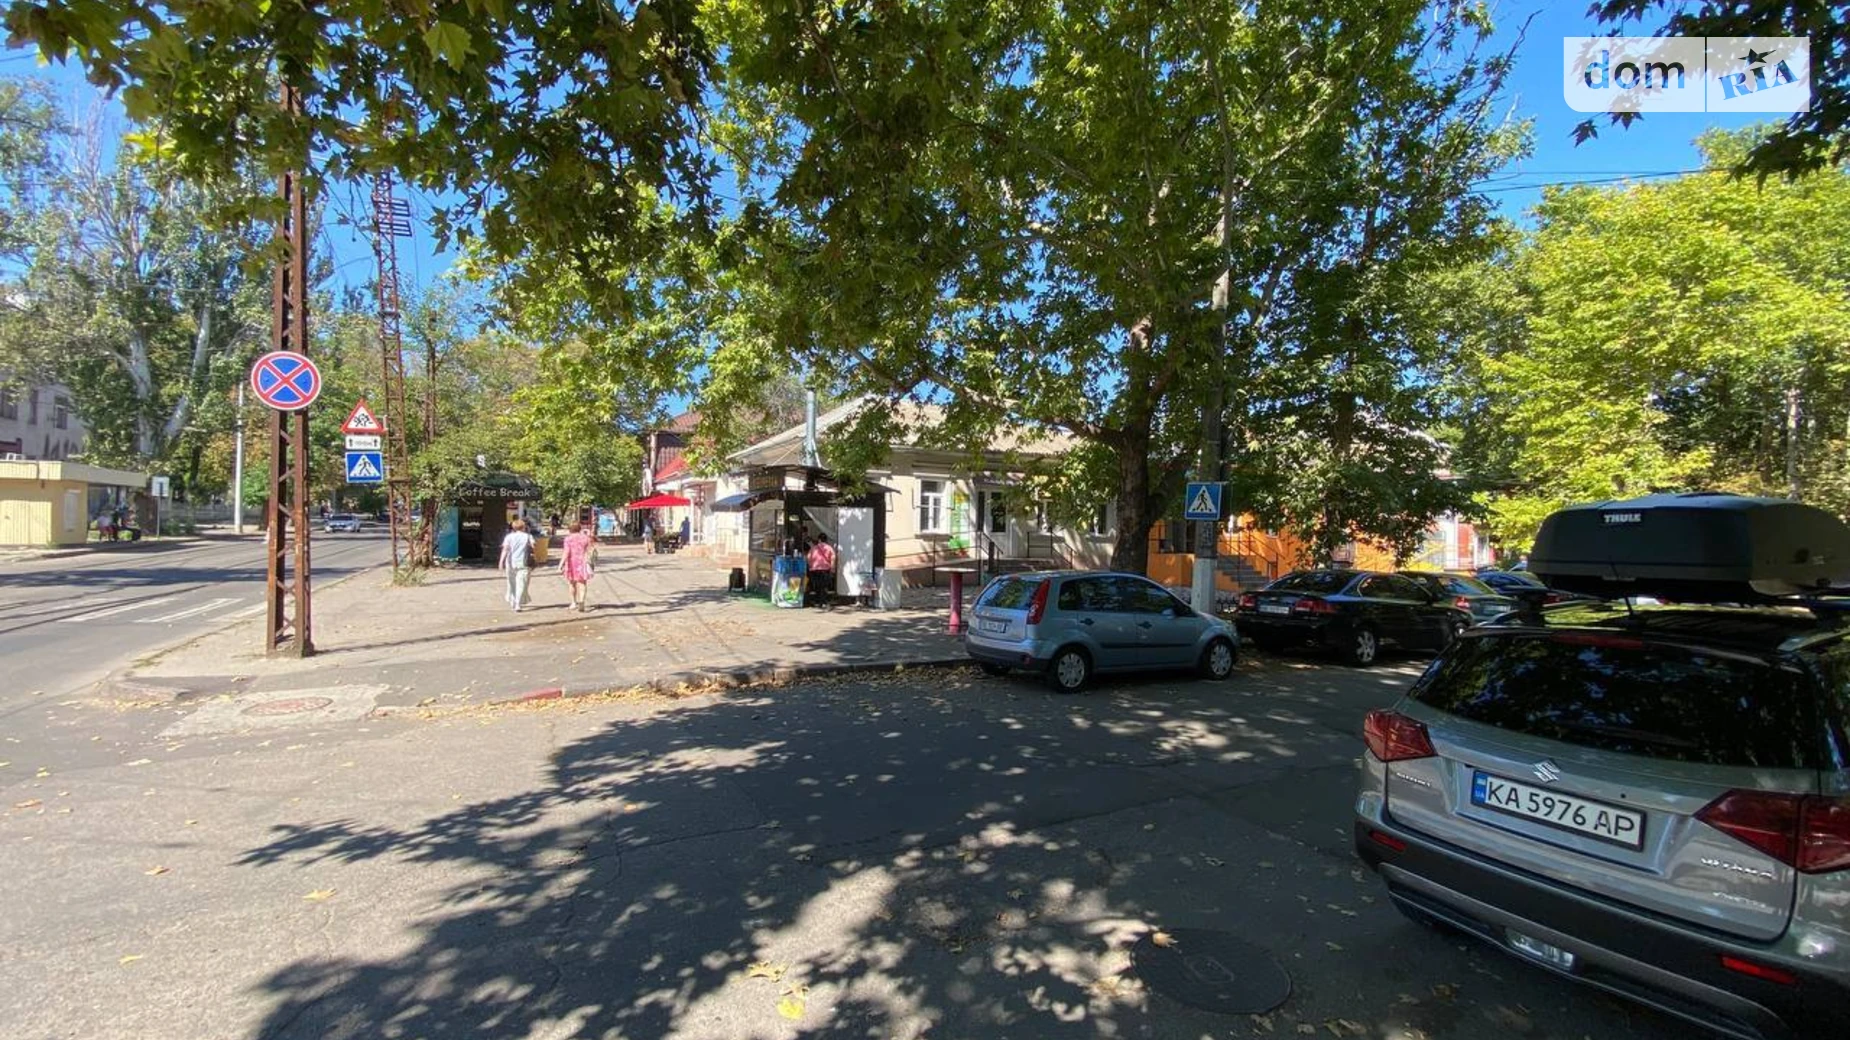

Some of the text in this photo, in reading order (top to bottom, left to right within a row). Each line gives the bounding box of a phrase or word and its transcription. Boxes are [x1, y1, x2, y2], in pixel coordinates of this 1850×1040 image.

[459, 487, 531, 498] Coffee Break
[1603, 512, 1642, 523] THULE
[1487, 781, 1635, 837] KA 5976 AP
